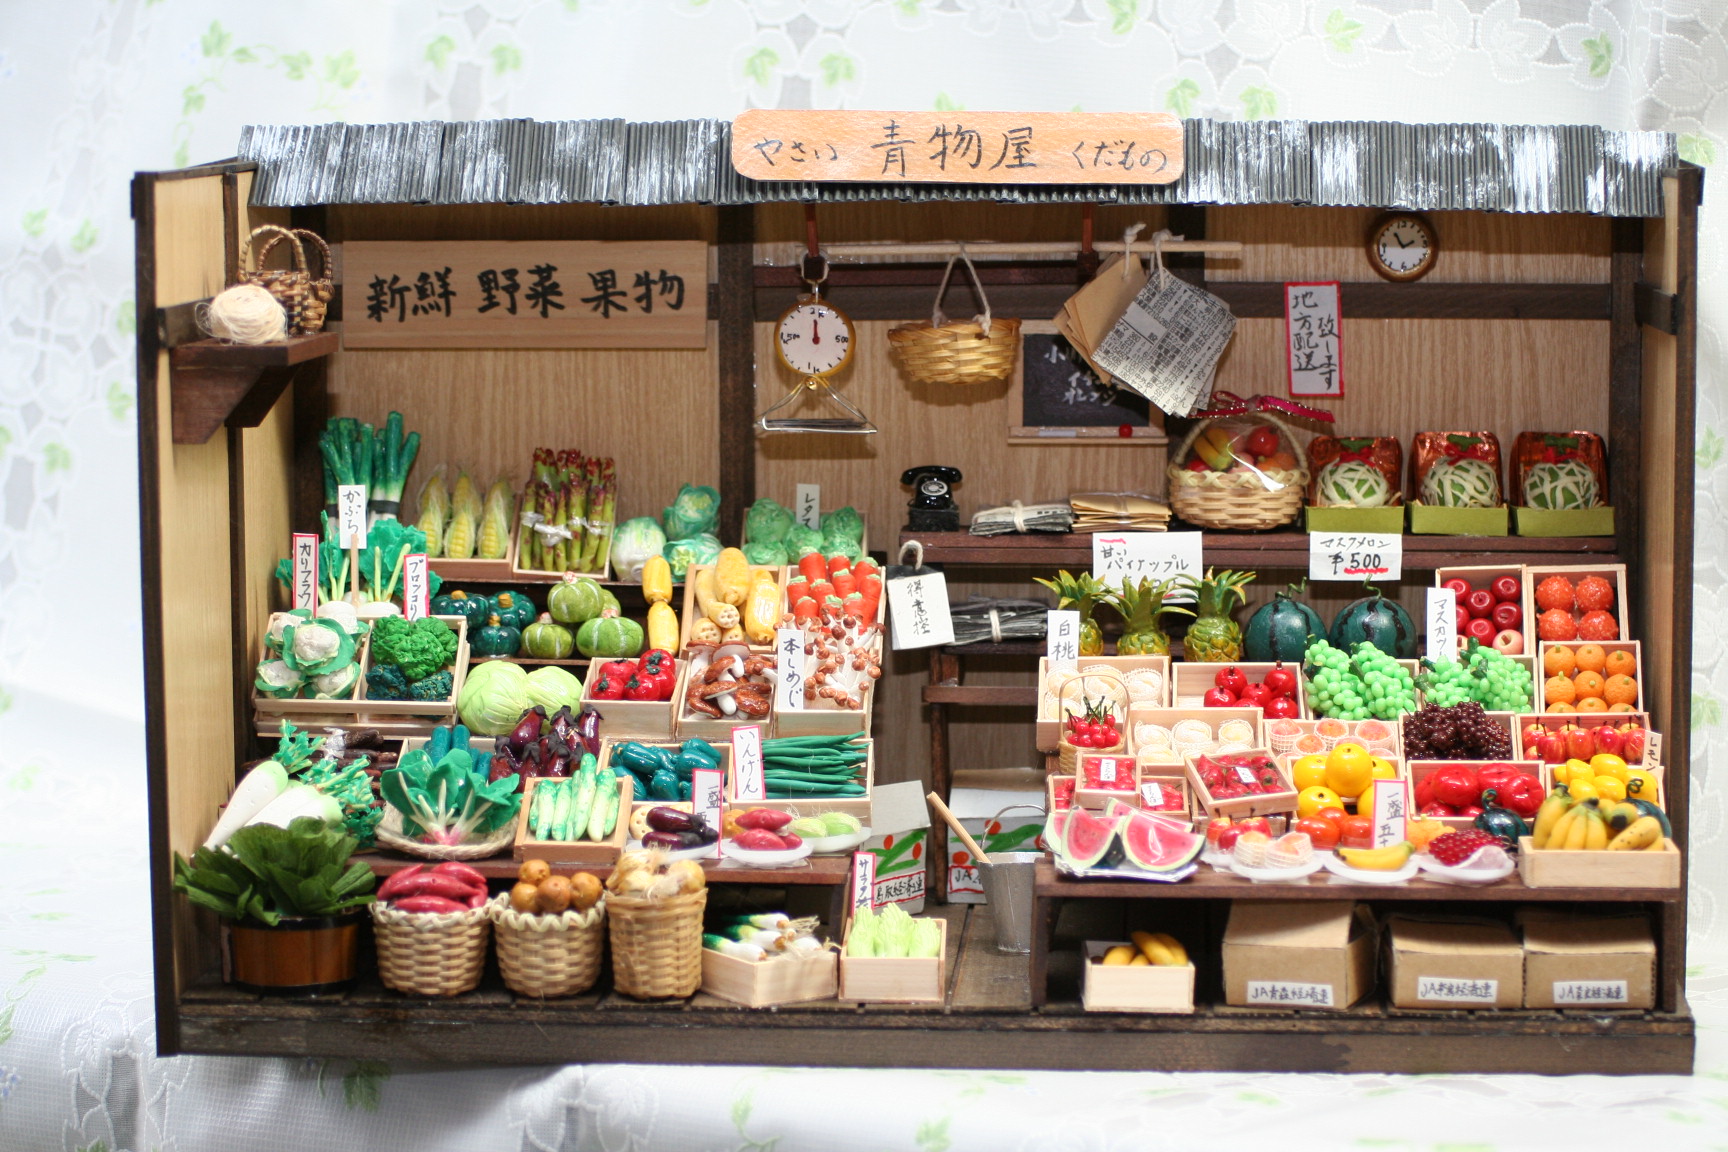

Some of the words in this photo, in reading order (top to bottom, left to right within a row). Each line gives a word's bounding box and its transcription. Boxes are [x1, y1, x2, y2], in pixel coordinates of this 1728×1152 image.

[753, 137, 839, 168] やさい
[870, 119, 1038, 179] 青物屋
[1071, 138, 1169, 172] くだもの
[367, 266, 458, 323] 新鮮
[476, 263, 566, 320] 野菜
[580, 268, 686, 320] 果物
[1291, 290, 1320, 372] 地方配送
[802, 492, 816, 530] レタス
[1100, 544, 1127, 560] 甘い
[1319, 536, 1392, 551] マスクメロン
[1051, 619, 1076, 661] 白桃
[783, 637, 803, 708] 本しめじ
[739, 730, 760, 795] いんげん
[1646, 736, 1659, 772] レモン
